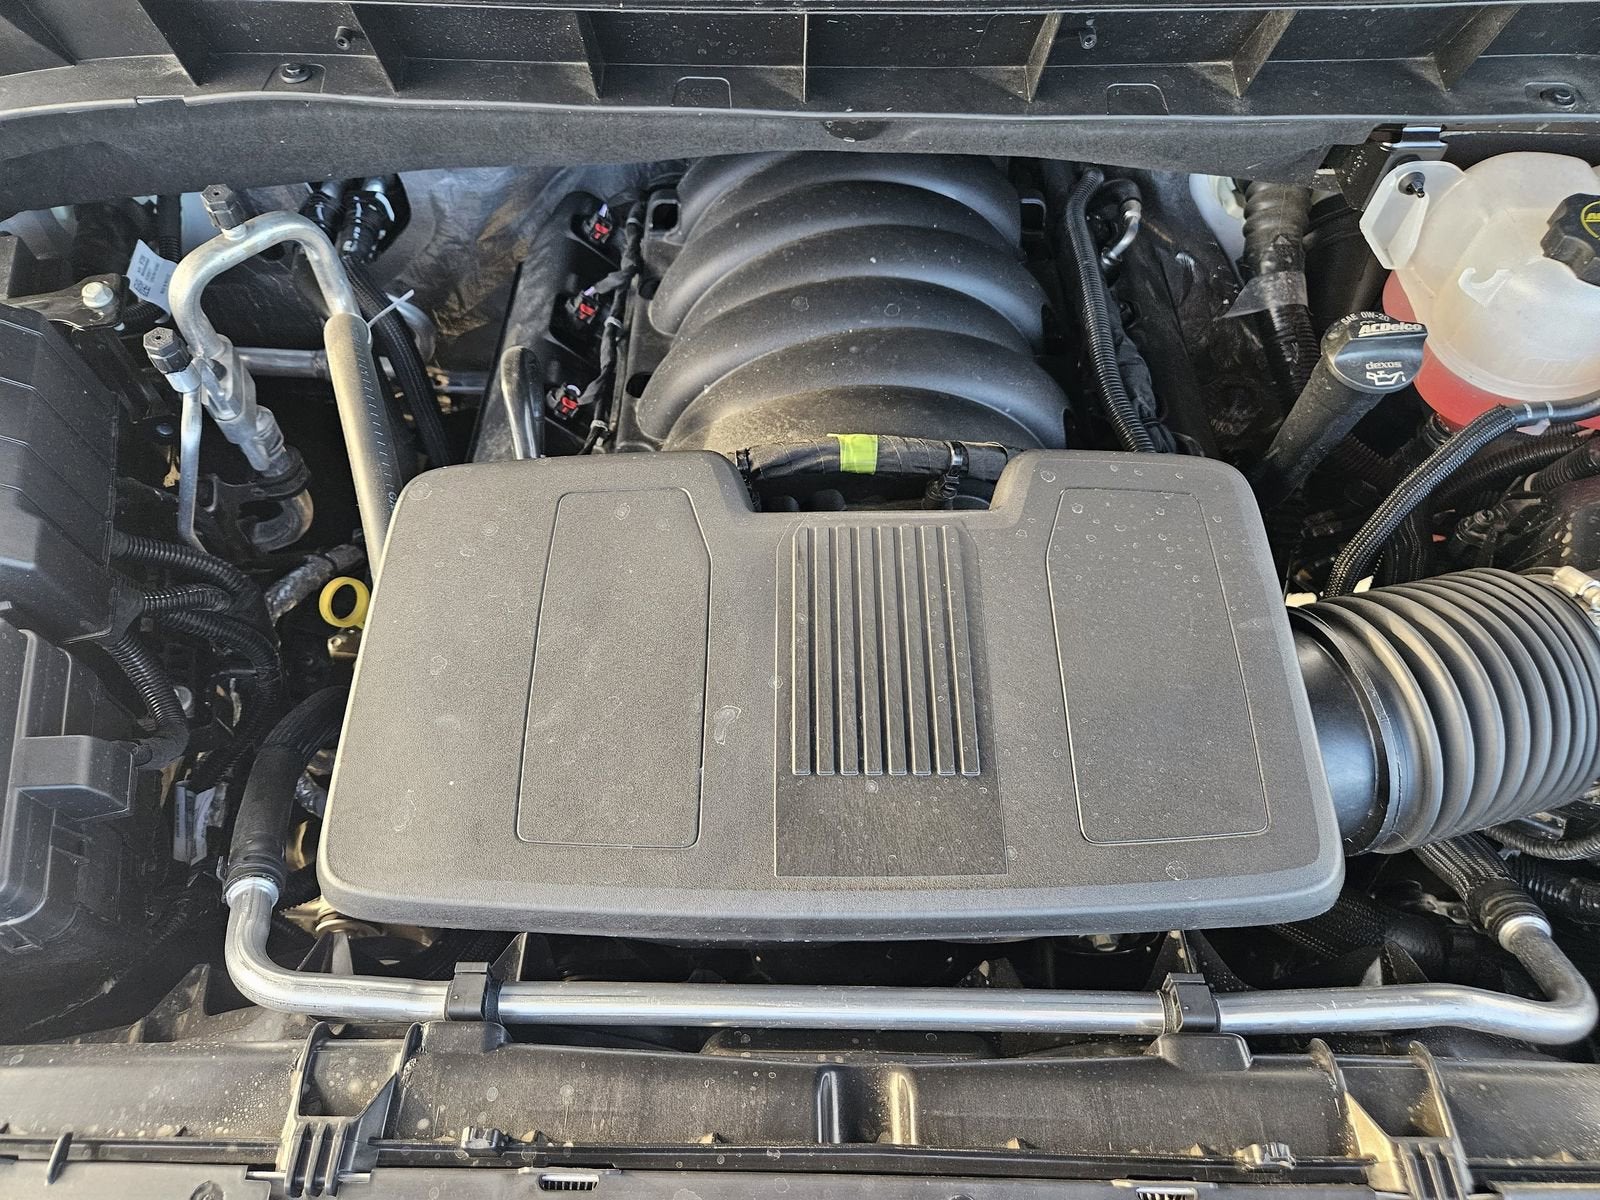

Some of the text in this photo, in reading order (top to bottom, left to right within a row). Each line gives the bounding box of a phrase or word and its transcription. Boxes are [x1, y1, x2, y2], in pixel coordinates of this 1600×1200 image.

[1341, 313, 1359, 325] SAE
[1360, 311, 1390, 322] 0W-20
[1358, 322, 1422, 335] ACDelco
[1366, 361, 1402, 370] dexos
